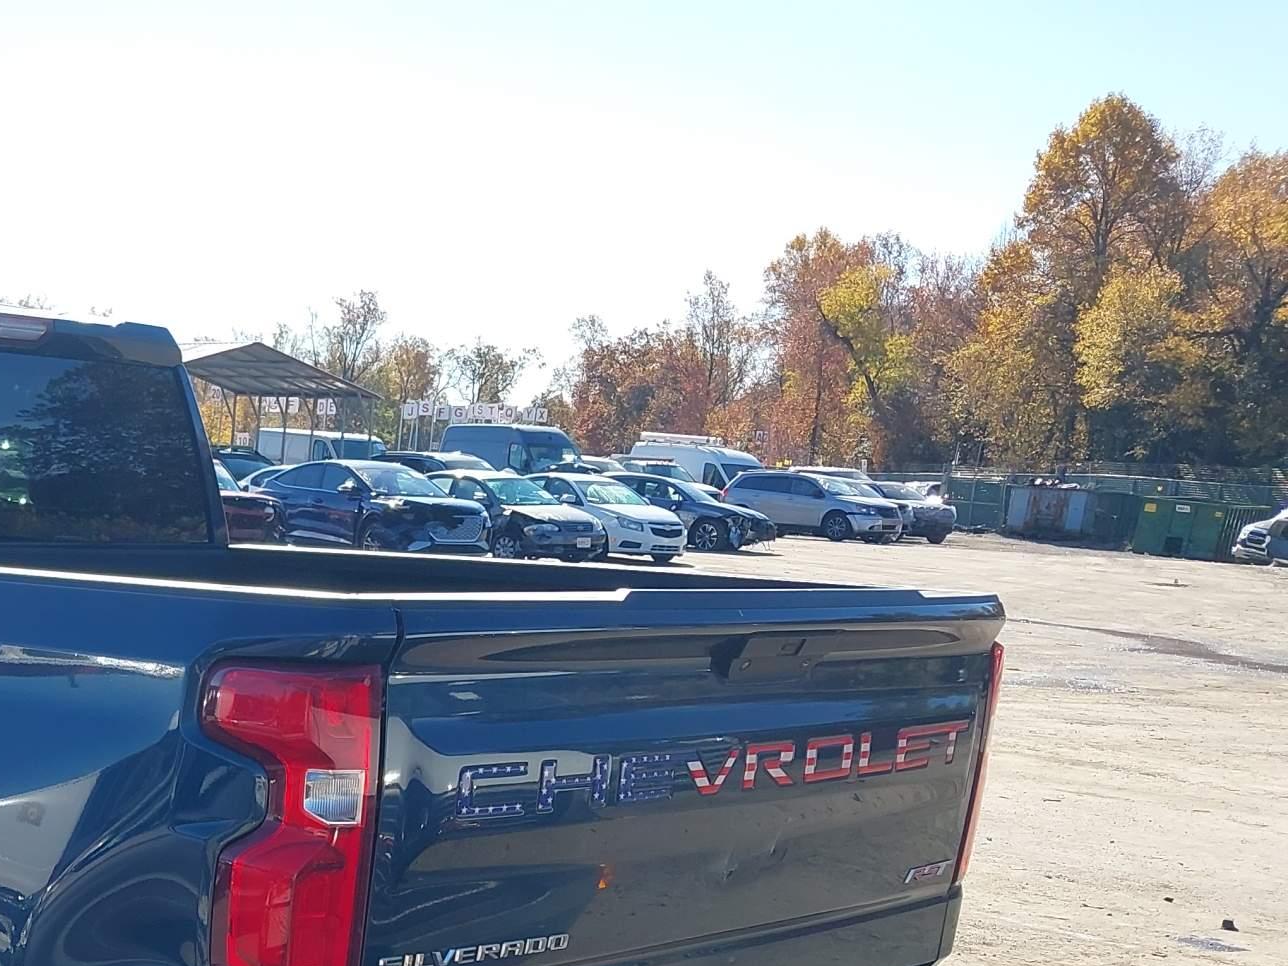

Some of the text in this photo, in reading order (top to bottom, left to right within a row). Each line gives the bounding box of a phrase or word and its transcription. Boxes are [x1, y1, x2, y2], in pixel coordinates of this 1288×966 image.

[421, 402, 430, 413] S
[438, 407, 446, 418] F
[454, 408, 463, 418] G
[455, 719, 970, 818] CHEVROLET
